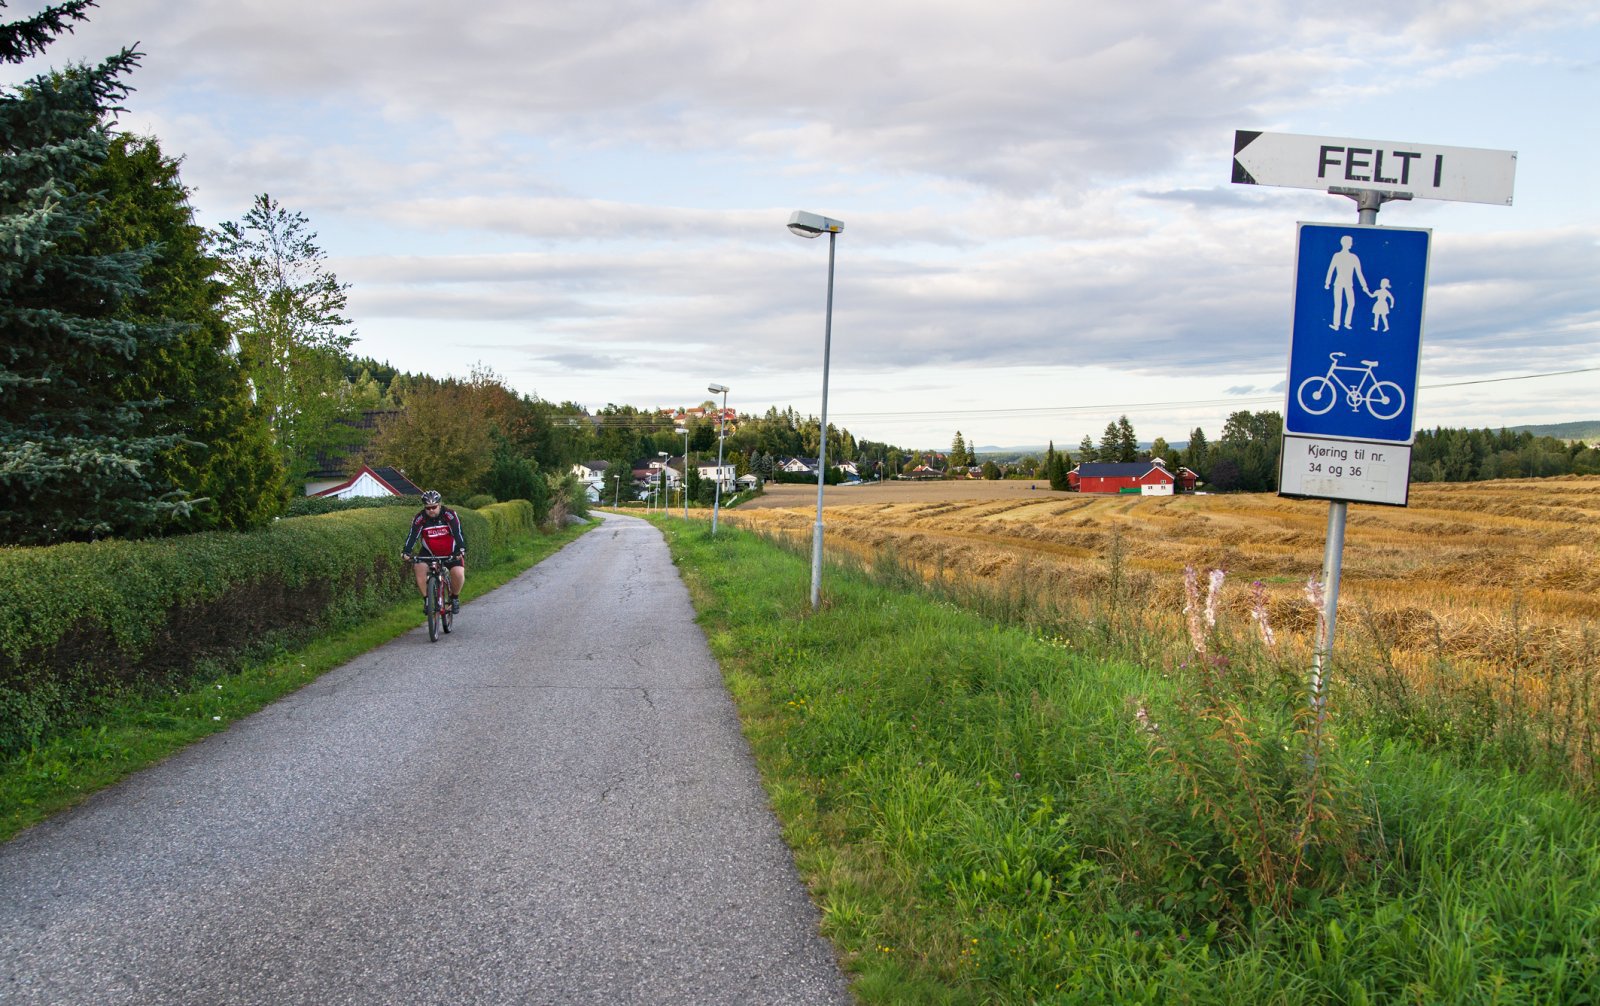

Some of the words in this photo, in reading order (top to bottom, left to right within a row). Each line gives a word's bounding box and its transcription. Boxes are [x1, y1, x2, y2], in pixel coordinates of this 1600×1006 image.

[1318, 145, 1421, 185] FELT
[1308, 444, 1347, 460] Kjøring
[1354, 449, 1365, 460] til
[1371, 452, 1386, 462] nr.
[1309, 462, 1321, 472] 34
[1328, 466, 1342, 477] og
[1349, 466, 1361, 476] 36
